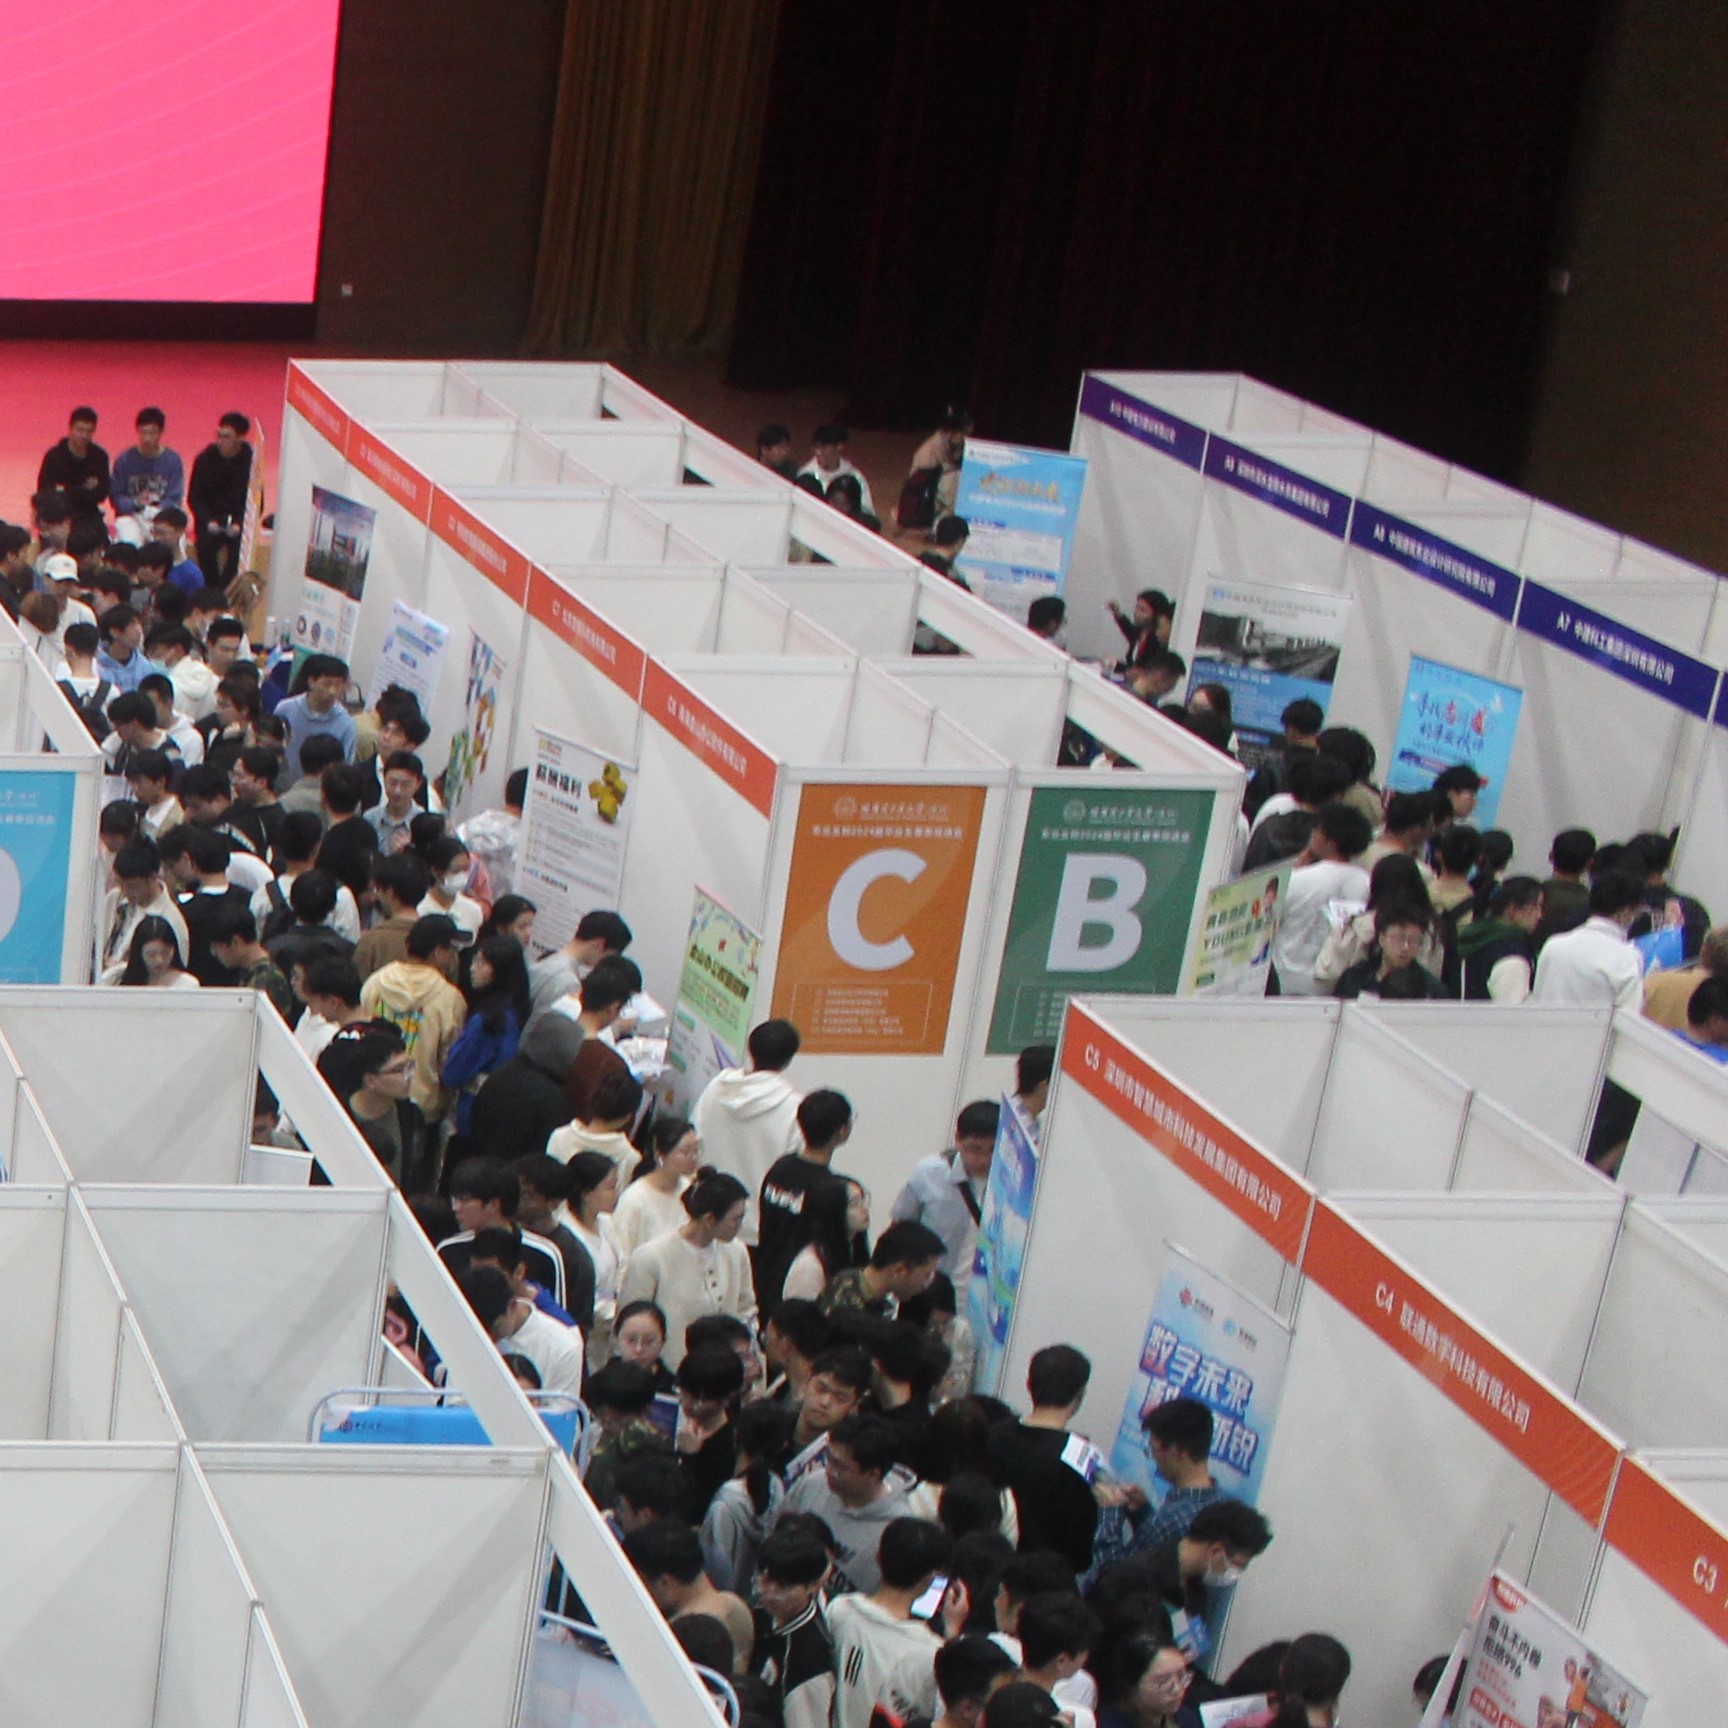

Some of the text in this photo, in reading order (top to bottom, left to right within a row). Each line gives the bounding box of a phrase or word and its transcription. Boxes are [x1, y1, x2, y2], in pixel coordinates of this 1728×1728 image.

[827, 847, 928, 972] C
[1045, 852, 1148, 973] B
[1085, 1043, 1100, 1072] C5
[1375, 1281, 1396, 1315] C4
[1142, 1323, 1252, 1412] 数字未来
[1693, 1554, 1718, 1594] C3
